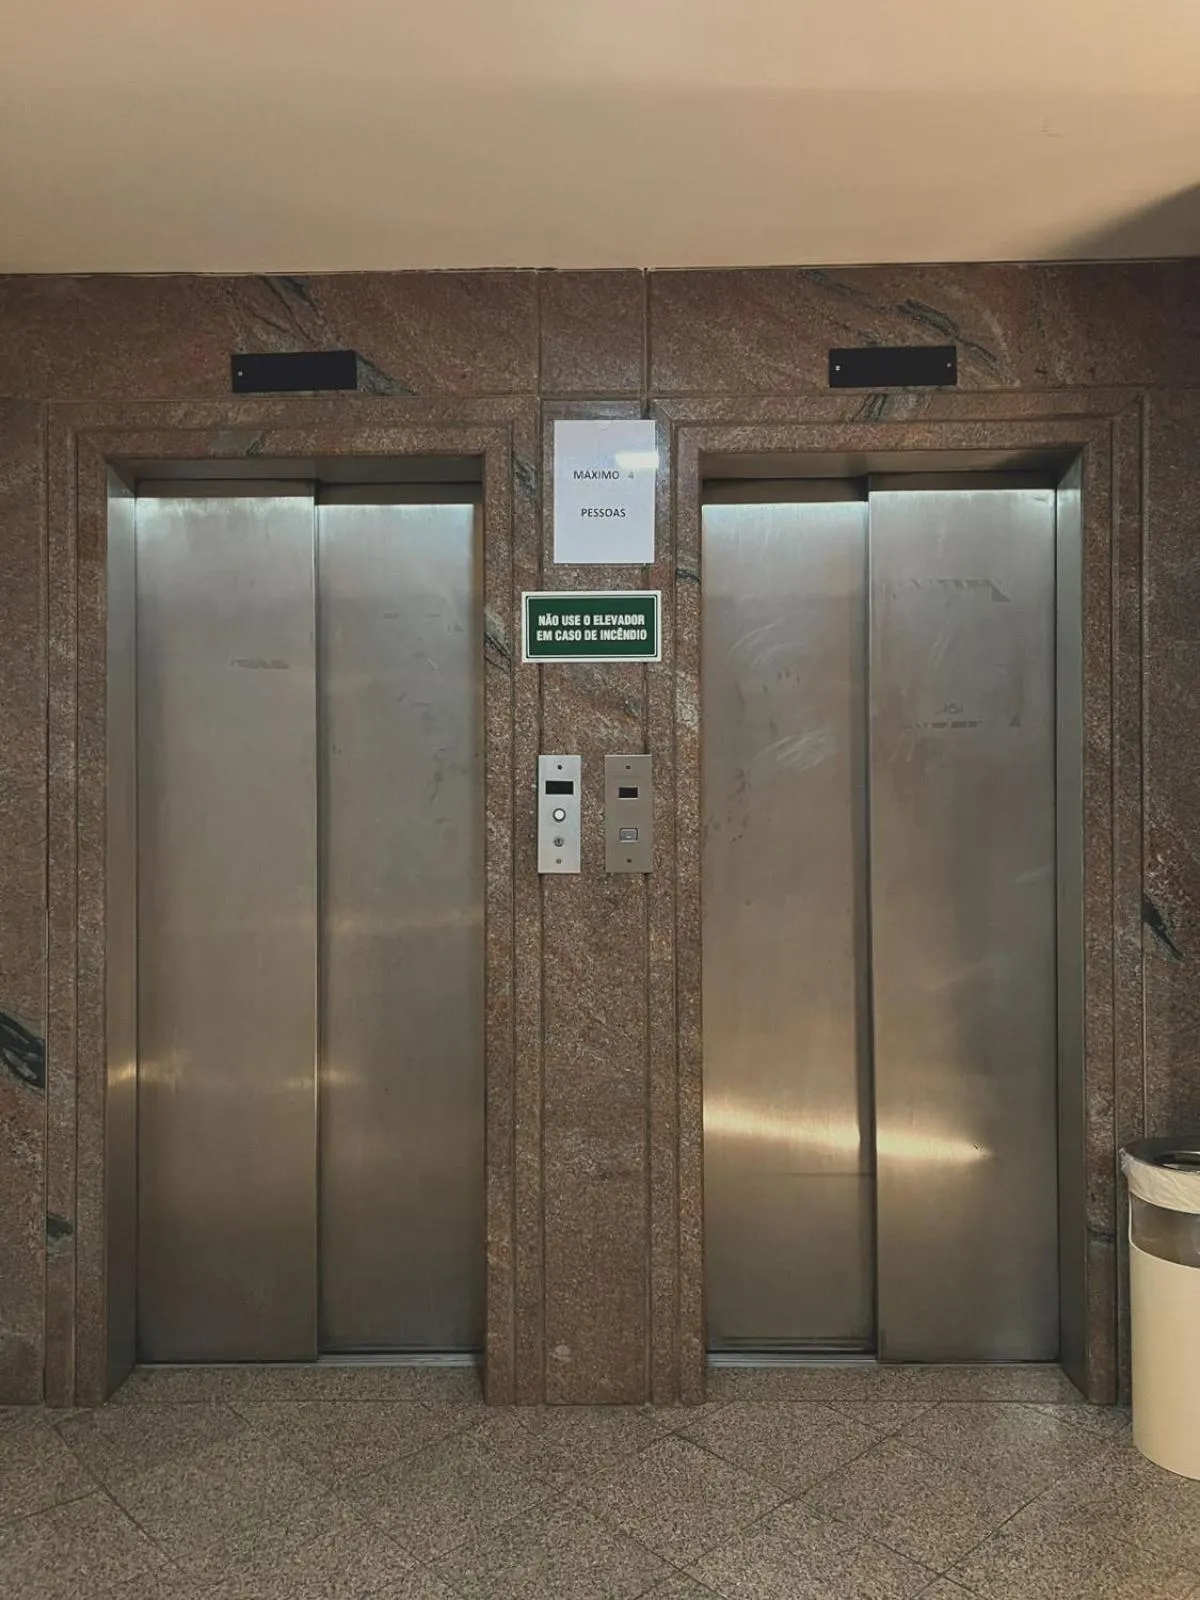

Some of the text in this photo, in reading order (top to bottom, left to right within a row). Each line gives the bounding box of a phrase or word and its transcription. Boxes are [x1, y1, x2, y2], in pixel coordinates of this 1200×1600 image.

[627, 471, 635, 480] 4
[581, 508, 626, 518] PESSOAS
[538, 613, 645, 626] NÃO USE O ELEVADOR
[537, 627, 647, 641] EM CASO DE INCÊNDIO
